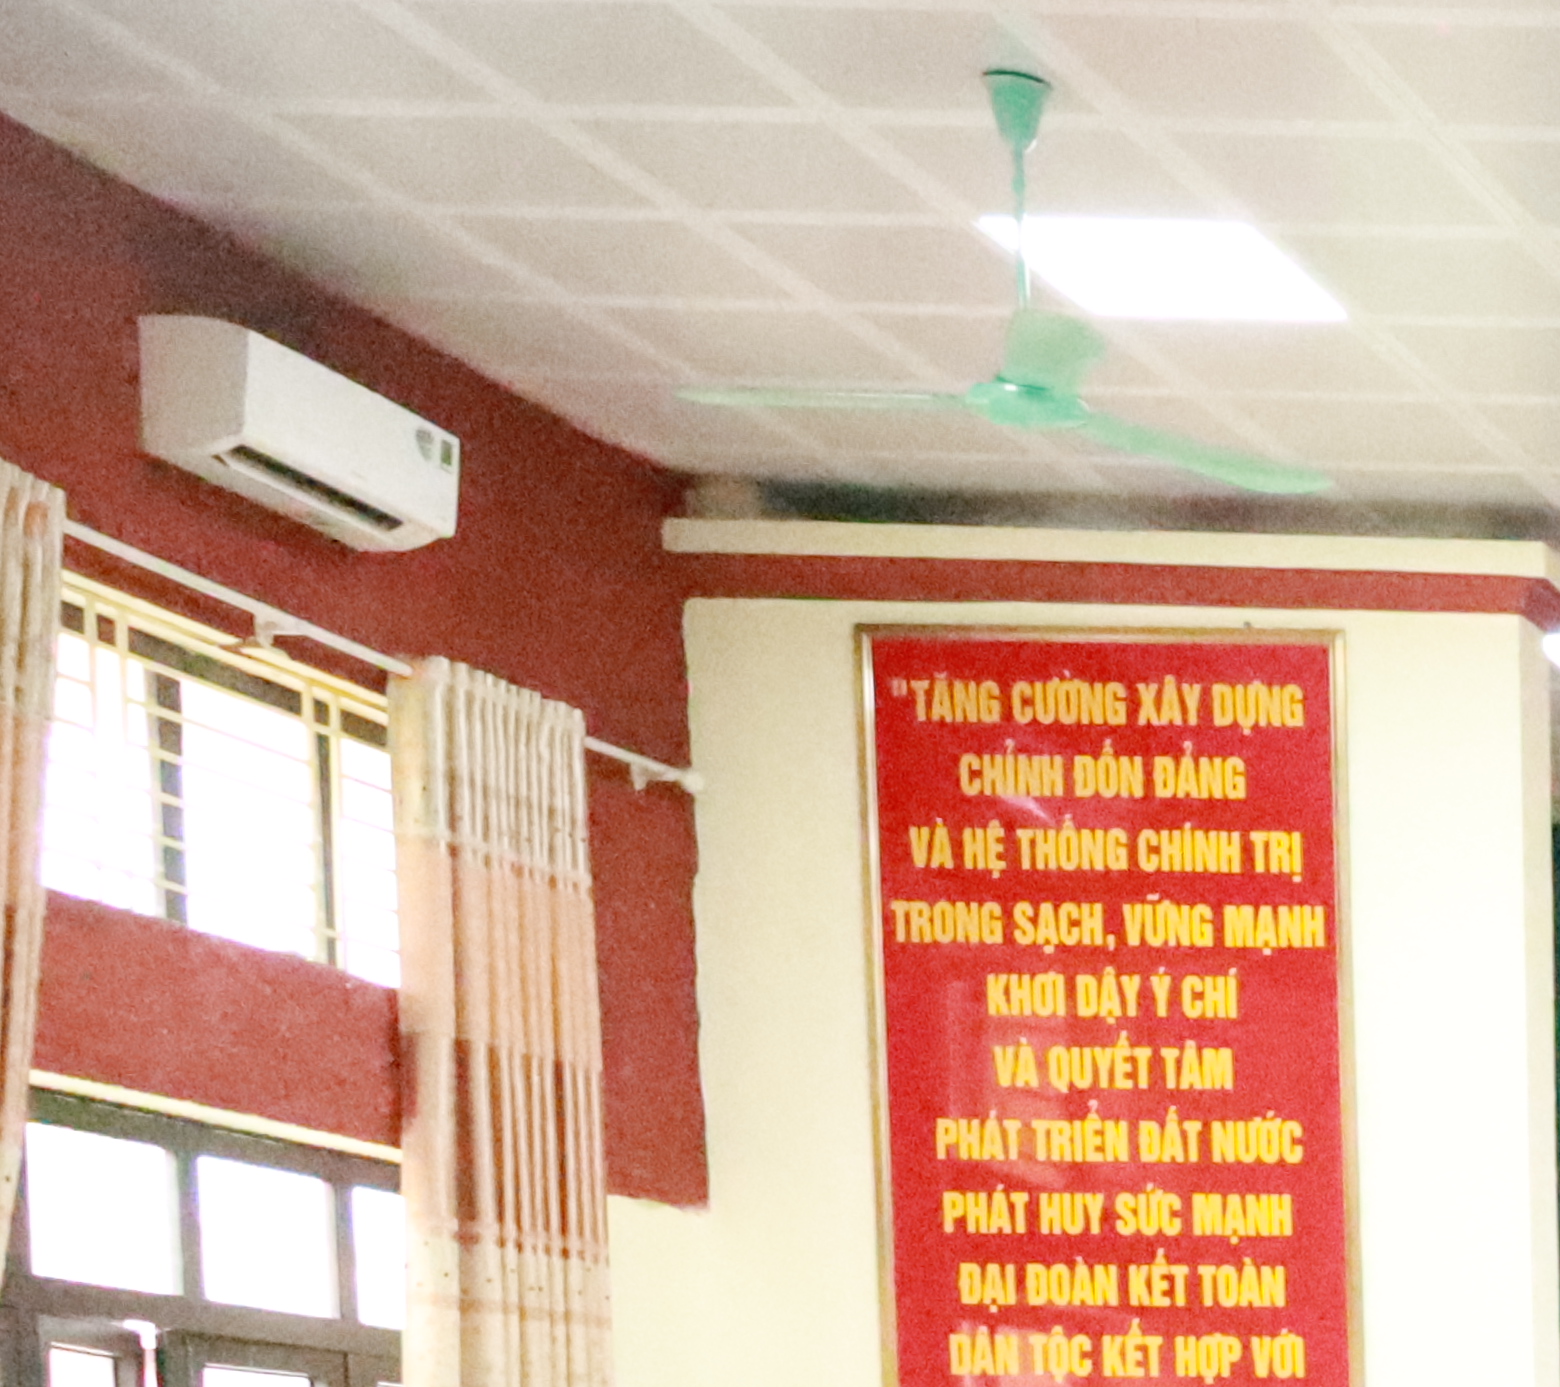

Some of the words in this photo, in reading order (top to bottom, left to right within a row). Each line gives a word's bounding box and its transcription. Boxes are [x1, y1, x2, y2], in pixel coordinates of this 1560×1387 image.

[892, 672, 1000, 722] "TĂNG
[1012, 670, 1126, 725] CƯỜNG
[1138, 675, 1201, 725] XÂY
[1213, 681, 1303, 734] DỰNG
[960, 740, 1063, 796] CHỈNH
[1073, 739, 1144, 798] ĐỐN
[1154, 741, 1246, 800] ĐẢNG
[910, 818, 952, 868] VÀ
[963, 820, 1005, 877] HỆ
[1017, 814, 1127, 870] THỐNG
[1138, 822, 1241, 873] CHÍNH
[1250, 831, 1302, 882] TRỊ
[892, 900, 1003, 943] TRONG
[1014, 902, 1115, 954] SẠCH,
[1123, 894, 1213, 947] VỮNG
[1225, 904, 1325, 954] MẠNH
[987, 972, 1066, 1017] KHƠI
[1077, 967, 1140, 1024] DẬY
[1151, 968, 1171, 1017] Ý
[1182, 968, 1238, 1019] CHÍ
[993, 1038, 1038, 1087] VÀ
[1048, 1031, 1152, 1092] QUYẾT
[1161, 1040, 1233, 1089] TÂM
[936, 1111, 1022, 1160] PHÁT
[1032, 1100, 1129, 1162] TRIỂN
[1139, 1106, 1202, 1162] ĐẤT
[1211, 1111, 1303, 1163] NƯỚC
[943, 1184, 1028, 1233] PHÁT
[1040, 1193, 1105, 1234] HUY
[1116, 1183, 1181, 1236] SỨC
[1193, 1194, 1292, 1244] MẠNH
[959, 1263, 1016, 1312] ĐẠI
[1026, 1256, 1118, 1306] ĐOÀN
[1129, 1248, 1189, 1306] KẾT
[1198, 1257, 1285, 1307] TOÀN
[949, 1326, 1019, 1375] DÂN
[1030, 1326, 1092, 1382] TỘC
[1103, 1318, 1163, 1378] KẾT
[1175, 1334, 1242, 1384] HỢP
[1251, 1328, 1305, 1378] VỚI
